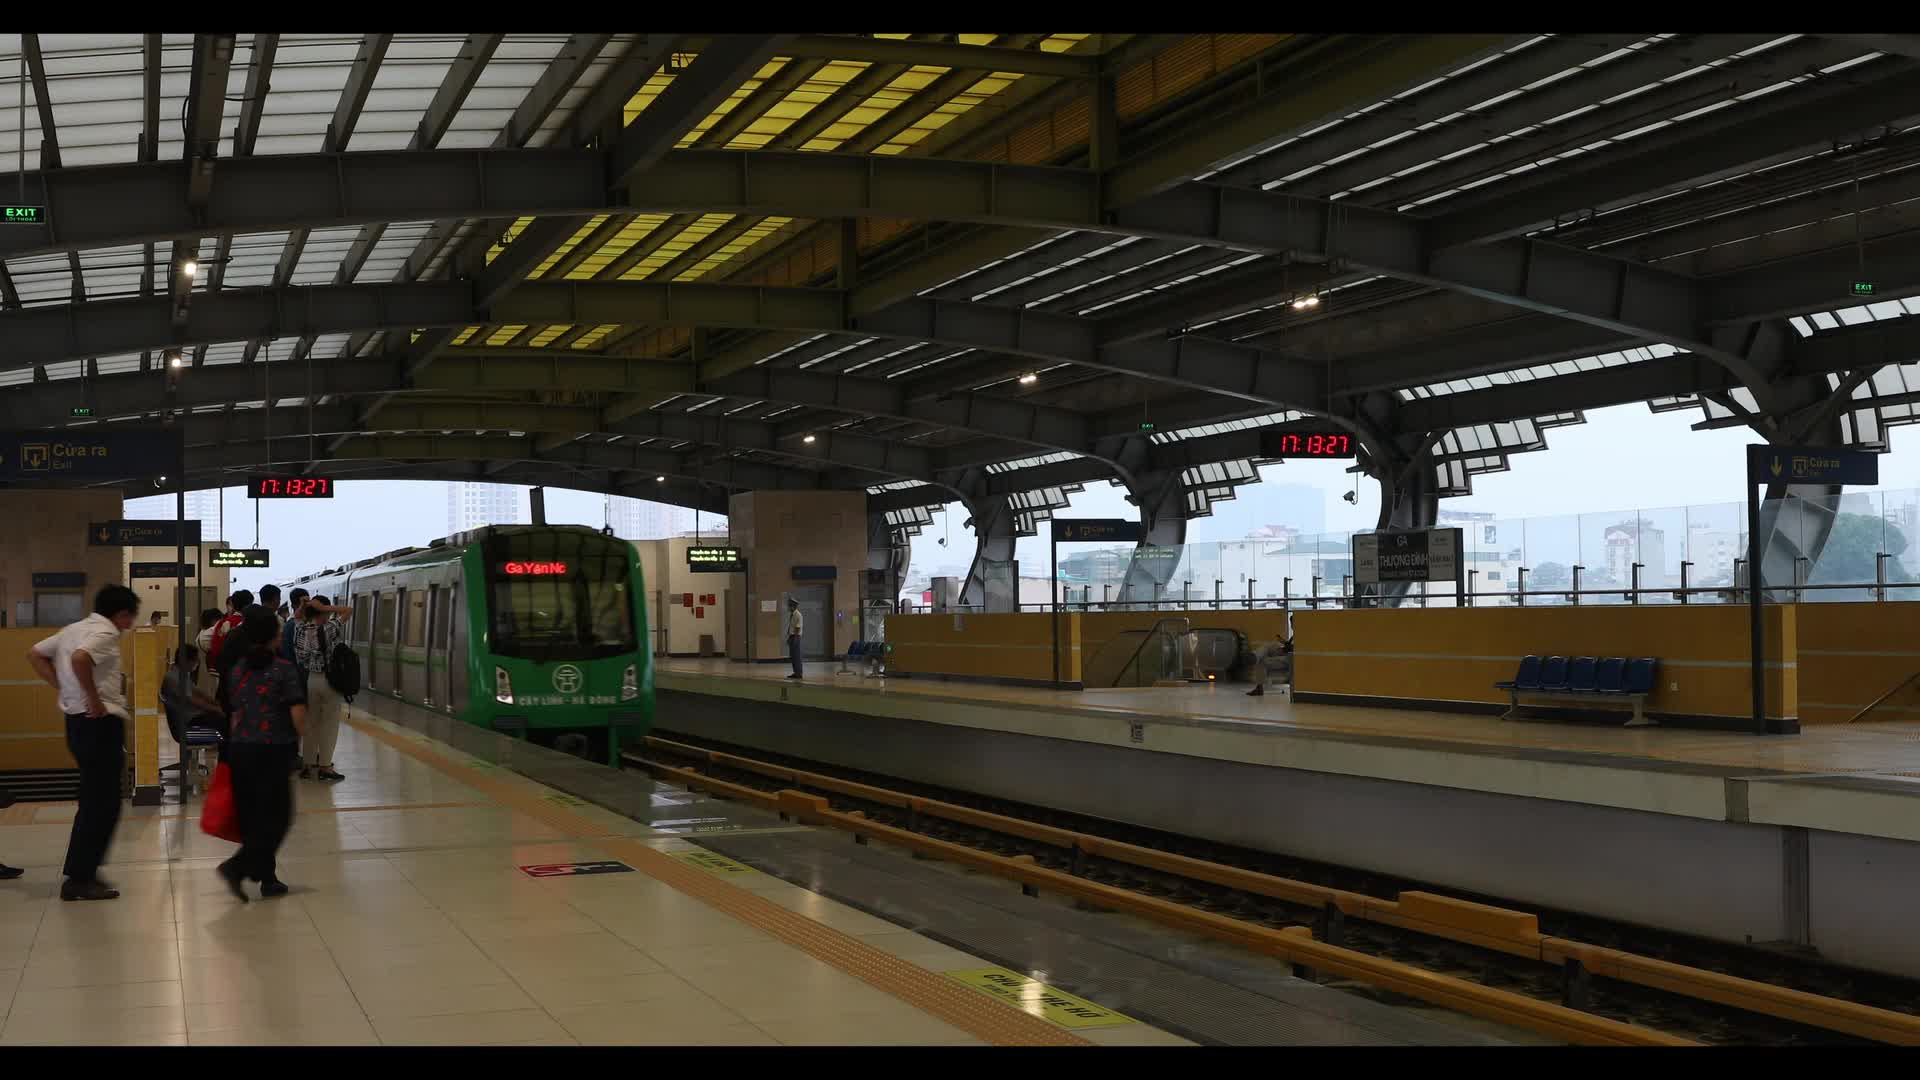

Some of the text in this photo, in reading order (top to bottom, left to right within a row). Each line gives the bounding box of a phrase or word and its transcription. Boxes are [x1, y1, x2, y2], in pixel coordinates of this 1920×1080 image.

[6, 208, 37, 217] EXIT
[1855, 283, 1873, 291] EXIT
[1281, 435, 1348, 454] 17:13:27
[261, 479, 327, 495] 17:13:27
[505, 562, 523, 574] Ga
